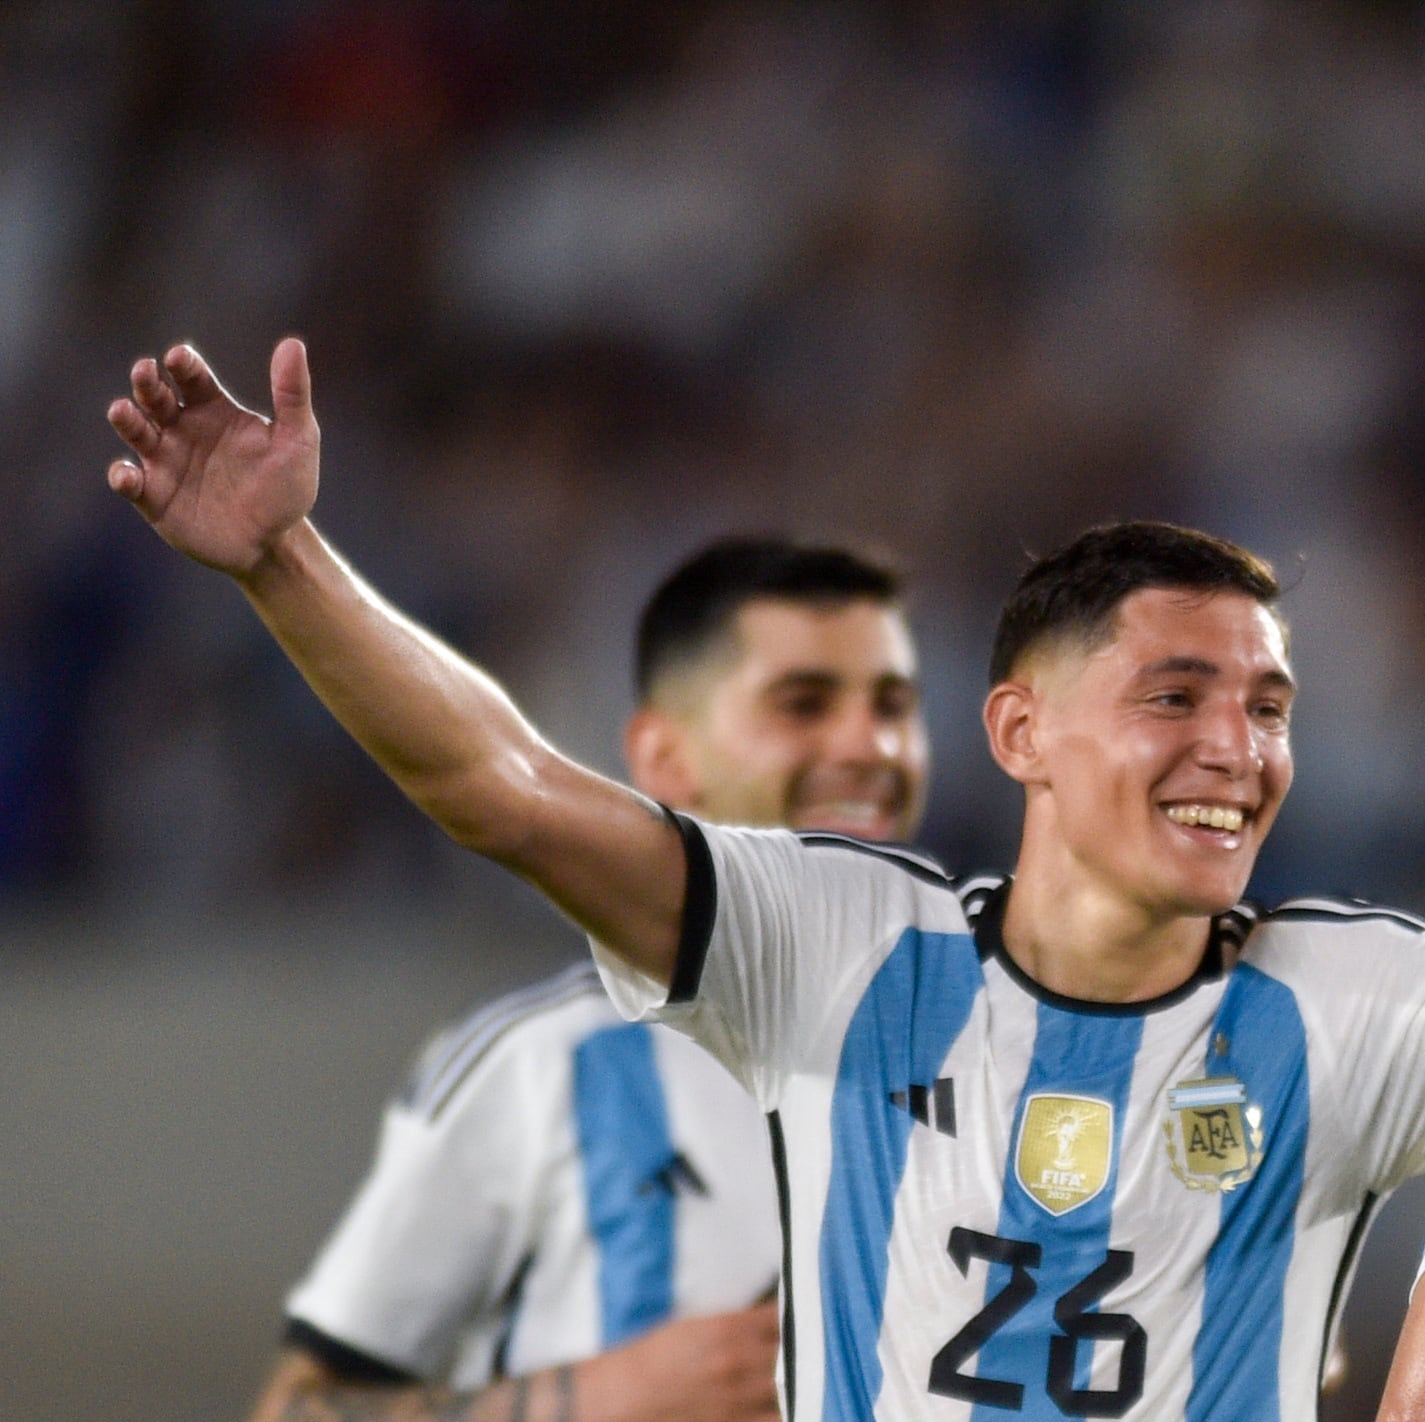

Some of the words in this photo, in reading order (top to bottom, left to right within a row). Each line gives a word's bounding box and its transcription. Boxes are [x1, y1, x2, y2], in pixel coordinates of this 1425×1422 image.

[1188, 1109, 1239, 1159] AFA
[1041, 1169, 1081, 1186] FIFA
[928, 1227, 1147, 1419] 26
